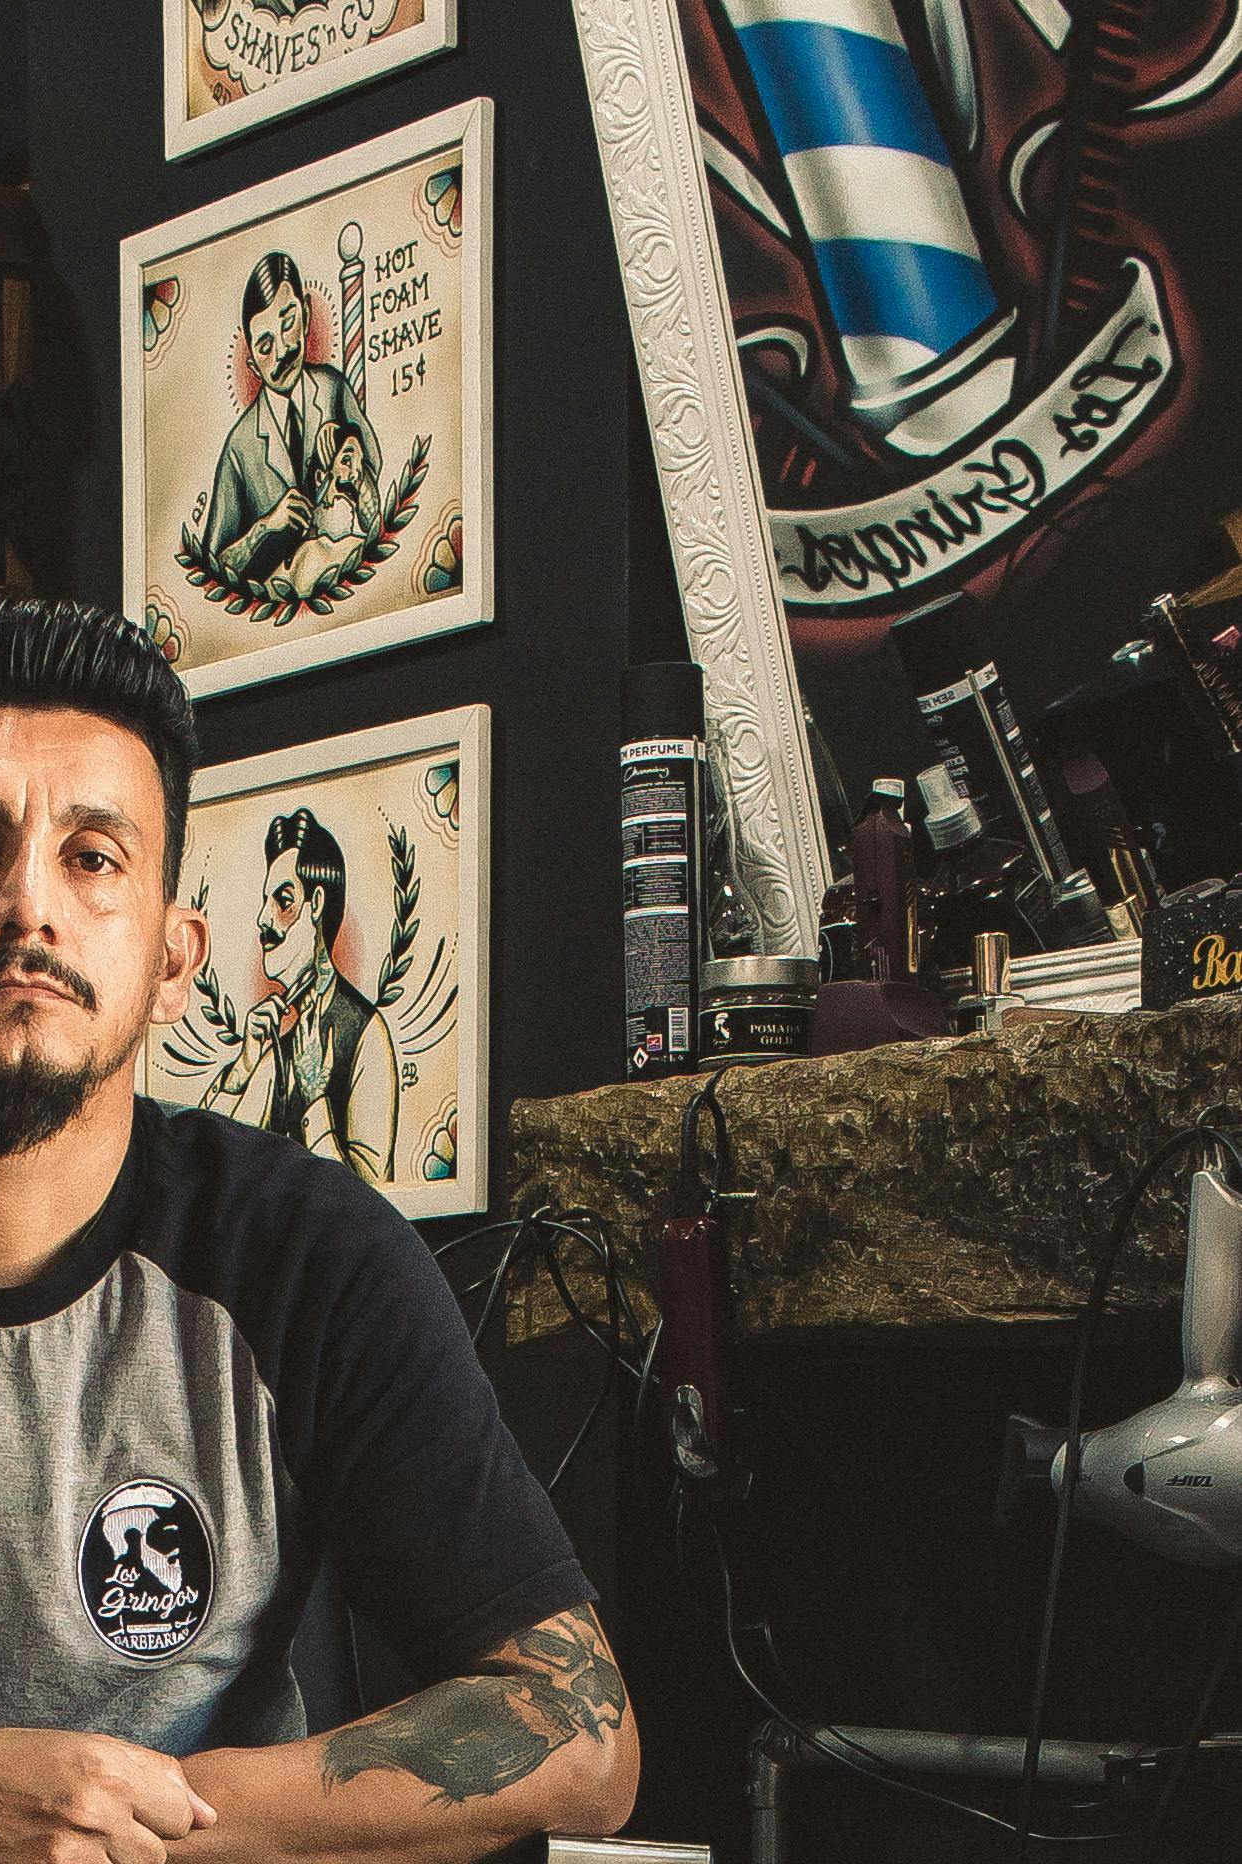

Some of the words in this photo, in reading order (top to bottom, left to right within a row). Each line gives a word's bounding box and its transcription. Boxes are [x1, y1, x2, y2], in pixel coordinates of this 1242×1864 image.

[224, 13, 320, 74] SHAVES
[374, 240, 418, 282] HOT
[370, 272, 429, 322] FOAM
[368, 308, 442, 362] SHAVE
[629, 743, 684, 758] PERFUME
[750, 1024, 800, 1034] POMADA
[760, 1035, 792, 1045] GOLD
[1166, 1475, 1214, 1488] TAIFF
[105, 1563, 141, 1587] Los
[98, 1586, 198, 1619] Gringos
[114, 1631, 186, 1650] BARBEARIA
